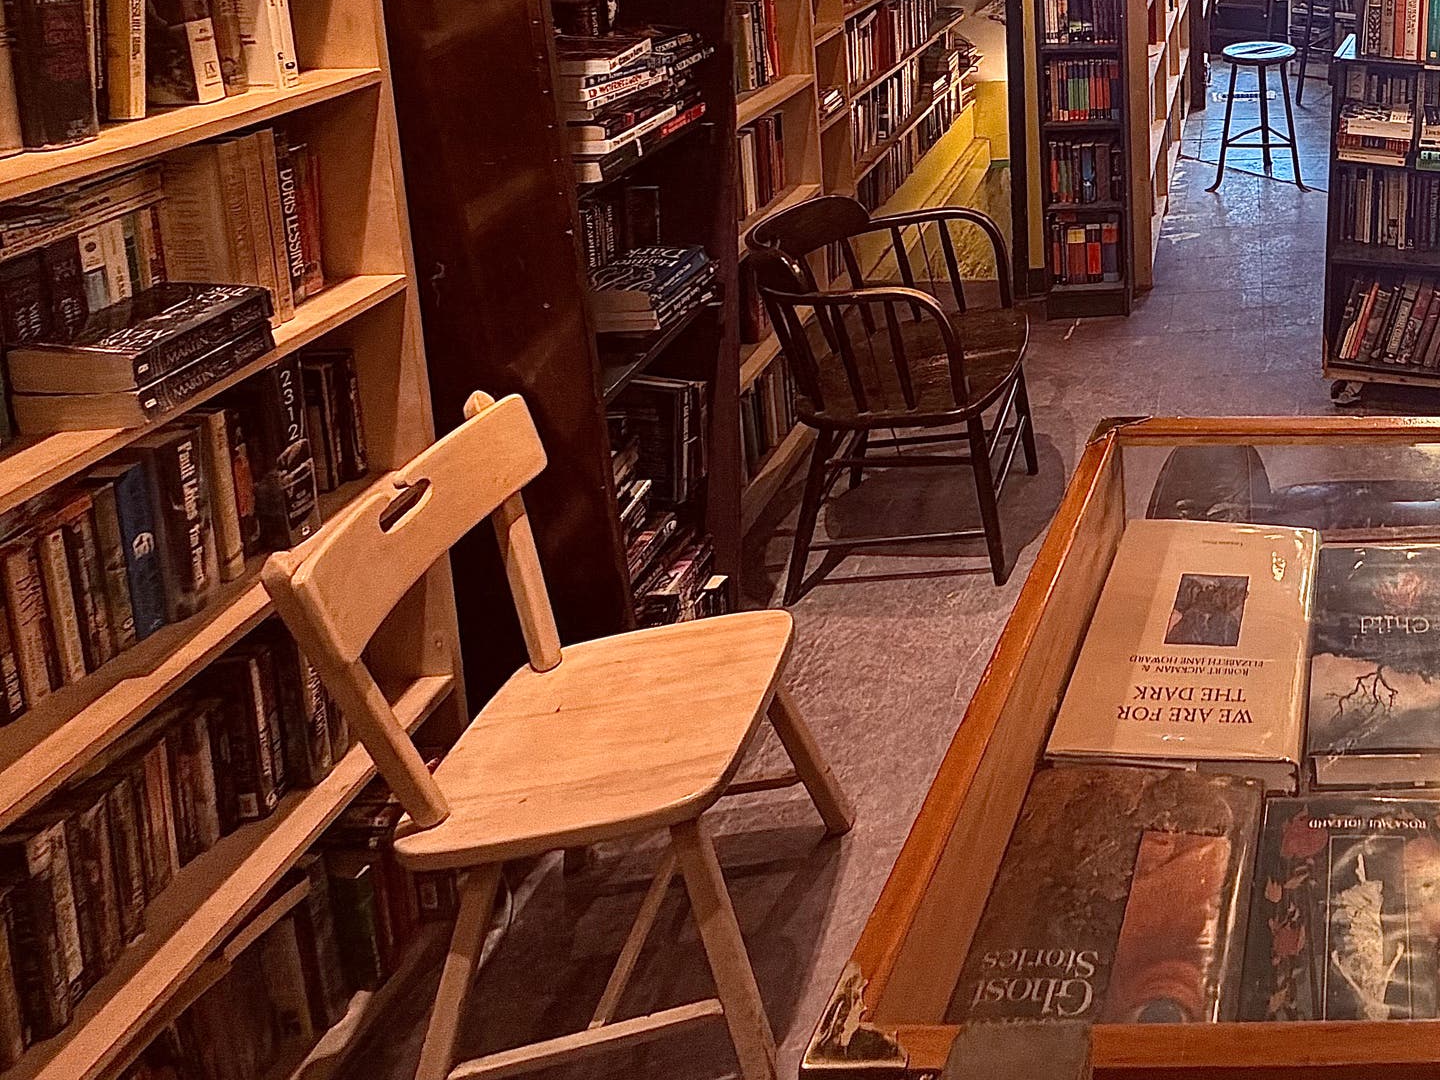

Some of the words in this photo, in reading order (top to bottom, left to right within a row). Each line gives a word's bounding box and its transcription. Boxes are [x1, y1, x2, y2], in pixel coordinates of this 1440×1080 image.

[280, 168, 297, 218] DORIS
[283, 218, 305, 277] LESSING
[172, 370, 215, 398] MARTIN
[1359, 615, 1431, 634] Child
[1129, 655, 1179, 665] HOWARD
[1180, 656, 1206, 666] JANE
[1208, 657, 1264, 668] ELIZABETH
[1156, 665, 1208, 675] AICKMAN
[1210, 667, 1249, 676] ROBERT
[1133, 686, 1194, 702] DARK
[1201, 687, 1246, 703] THE
[1118, 705, 1162, 721] FOR
[1169, 707, 1214, 724] ARE
[1215, 707, 1253, 724] WE
[983, 948, 1099, 978] Stories
[969, 978, 1093, 1016] Ghost
